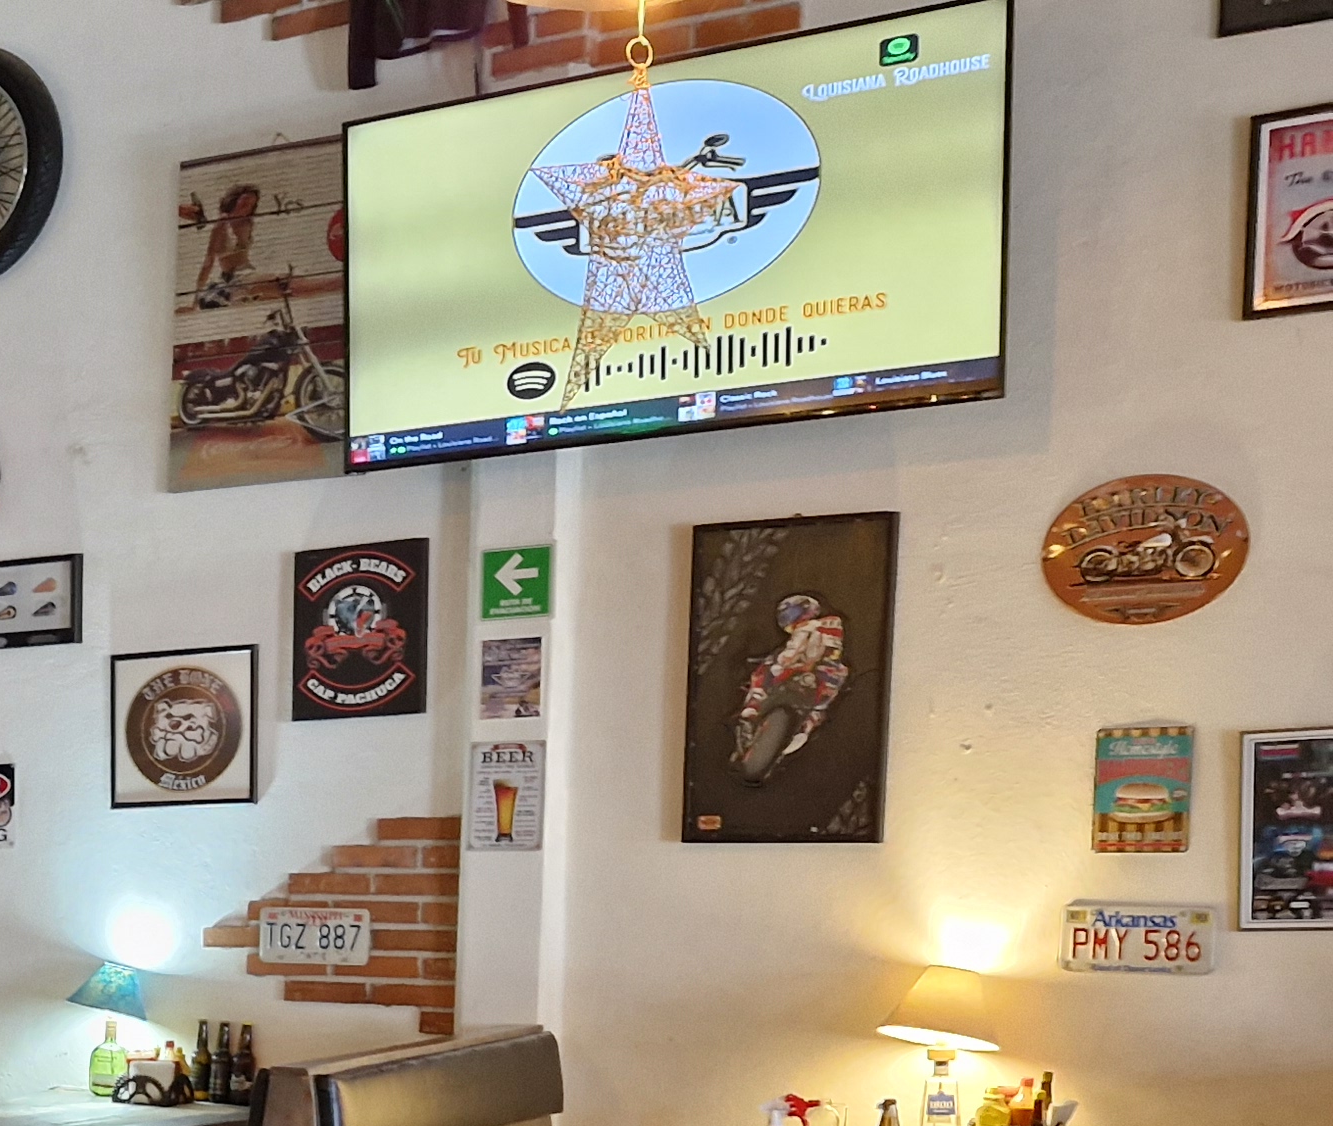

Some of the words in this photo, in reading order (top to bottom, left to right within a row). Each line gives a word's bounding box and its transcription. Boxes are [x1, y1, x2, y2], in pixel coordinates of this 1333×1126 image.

[893, 53, 991, 87] ROADHOUSE
[493, 337, 573, 361] MUSICA
[712, 305, 788, 329] DONDE
[801, 292, 888, 318] QUIERAS
[358, 558, 407, 583] BEARS
[480, 750, 535, 764] BEER
[1091, 908, 1178, 929] Arkansas
[265, 922, 307, 950] TGZ
[318, 923, 362, 951] 887
[1071, 927, 1129, 960] PMY
[1143, 928, 1202, 962] 586
